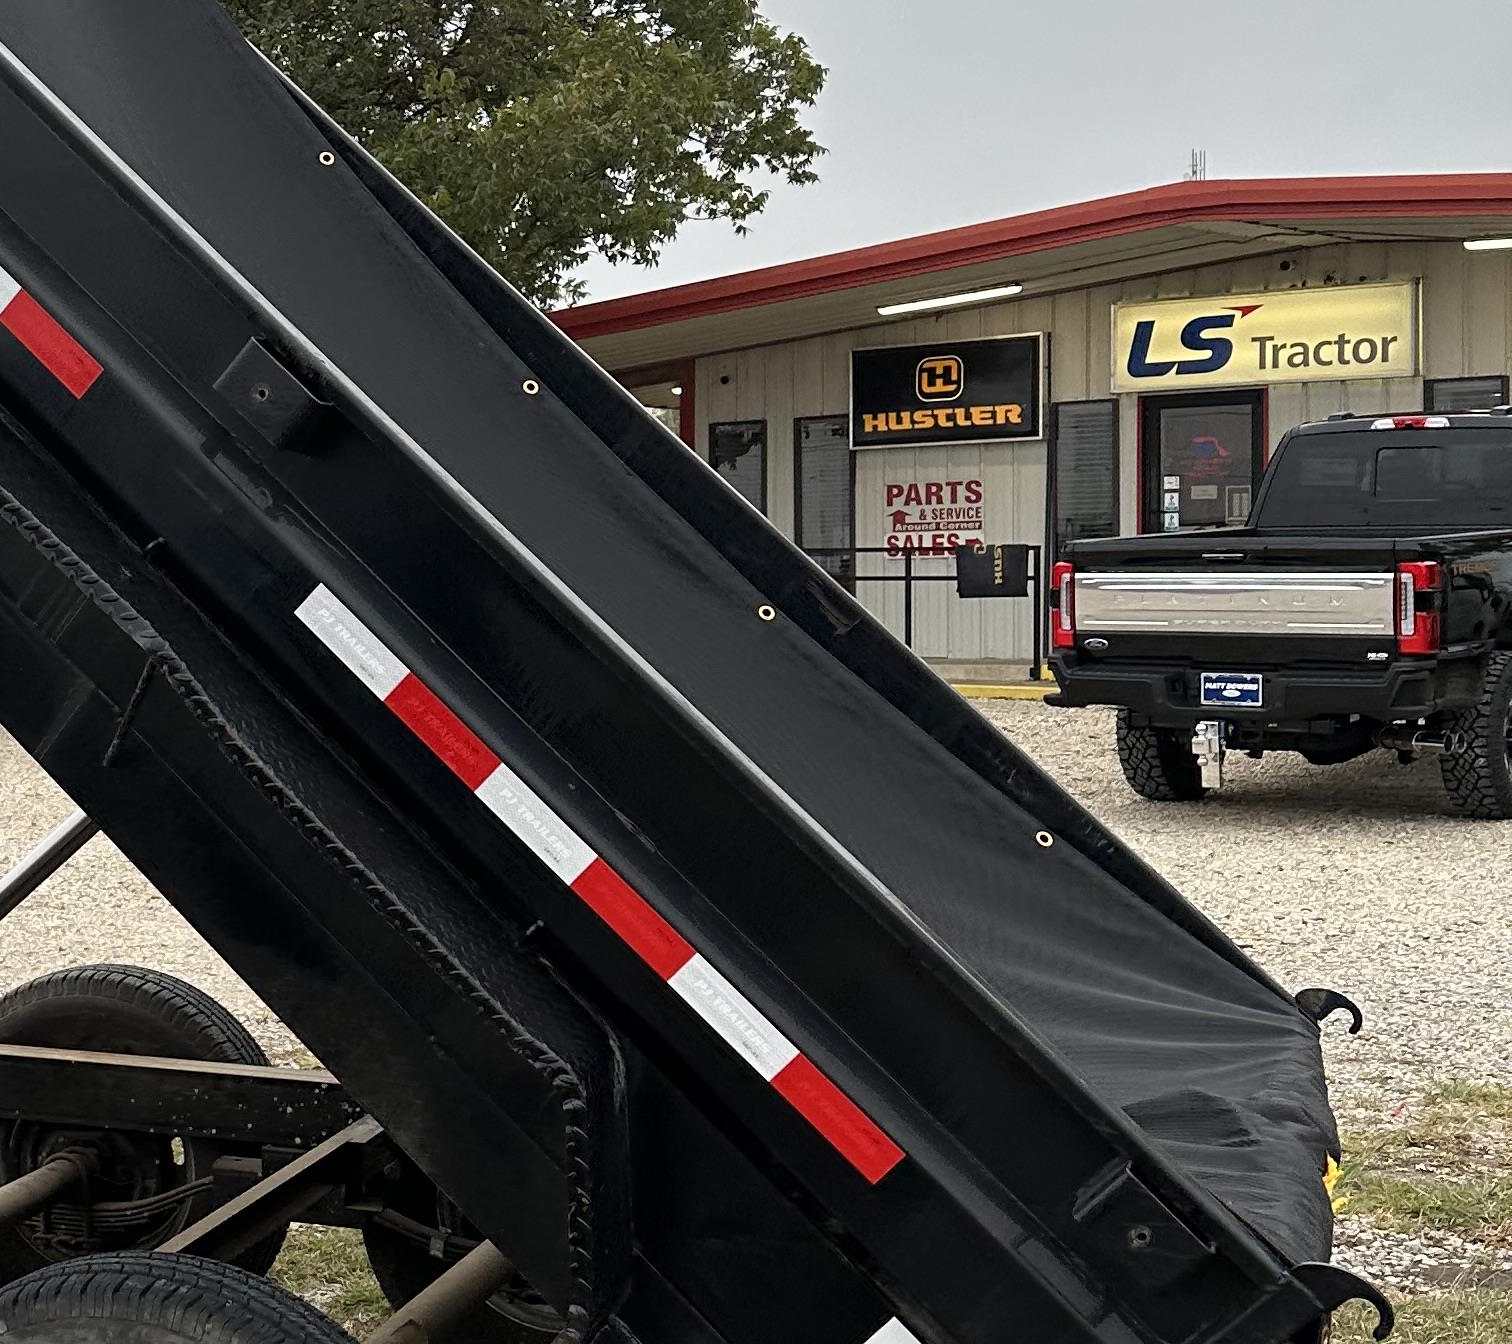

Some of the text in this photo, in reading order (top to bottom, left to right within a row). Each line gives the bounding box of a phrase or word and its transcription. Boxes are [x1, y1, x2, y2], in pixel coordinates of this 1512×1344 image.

[1126, 314, 1398, 378] LS Tractor
[862, 404, 1023, 433] HUSTLER
[886, 480, 982, 506] PARTS
[895, 521, 981, 532] Around Corner
[918, 507, 982, 521] & SERVICE
[886, 533, 960, 557] SALES
[317, 606, 335, 625] PJ
[333, 623, 386, 675] TRAILERS
[498, 786, 518, 805] PJ
[515, 802, 572, 859] TRAILERS
[693, 977, 714, 998] PJ
[712, 995, 771, 1054] TRAILERS
